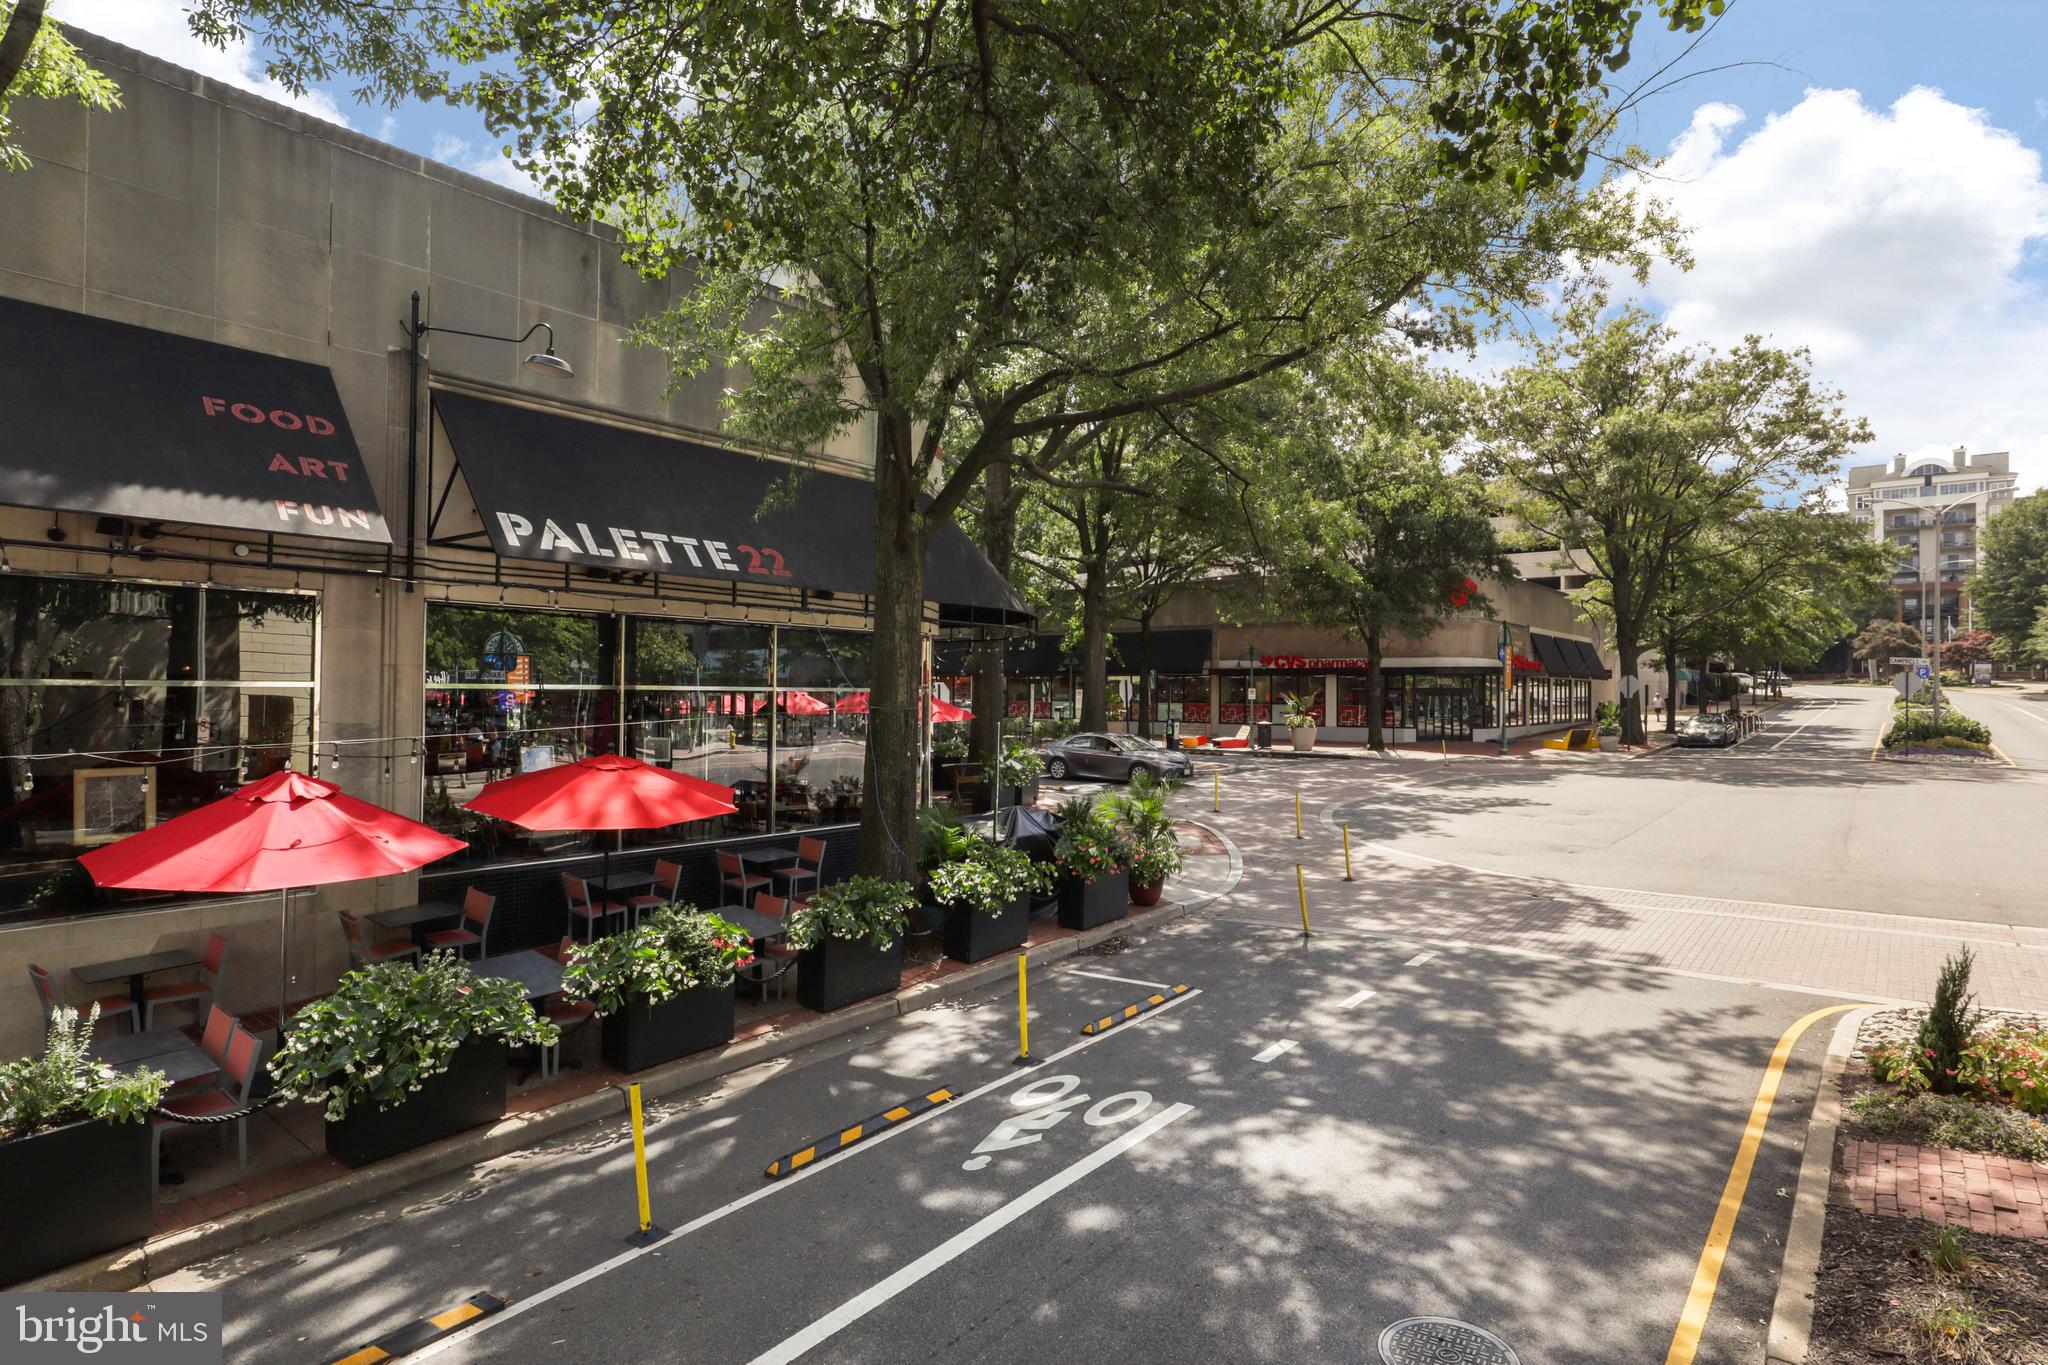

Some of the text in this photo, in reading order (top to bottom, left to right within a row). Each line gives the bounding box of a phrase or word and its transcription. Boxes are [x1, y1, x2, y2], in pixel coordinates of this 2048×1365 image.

[202, 396, 335, 435] FOOD
[268, 453, 348, 481] ART
[275, 500, 370, 530] FUN
[1273, 655, 1369, 671] CVS pharmacy
